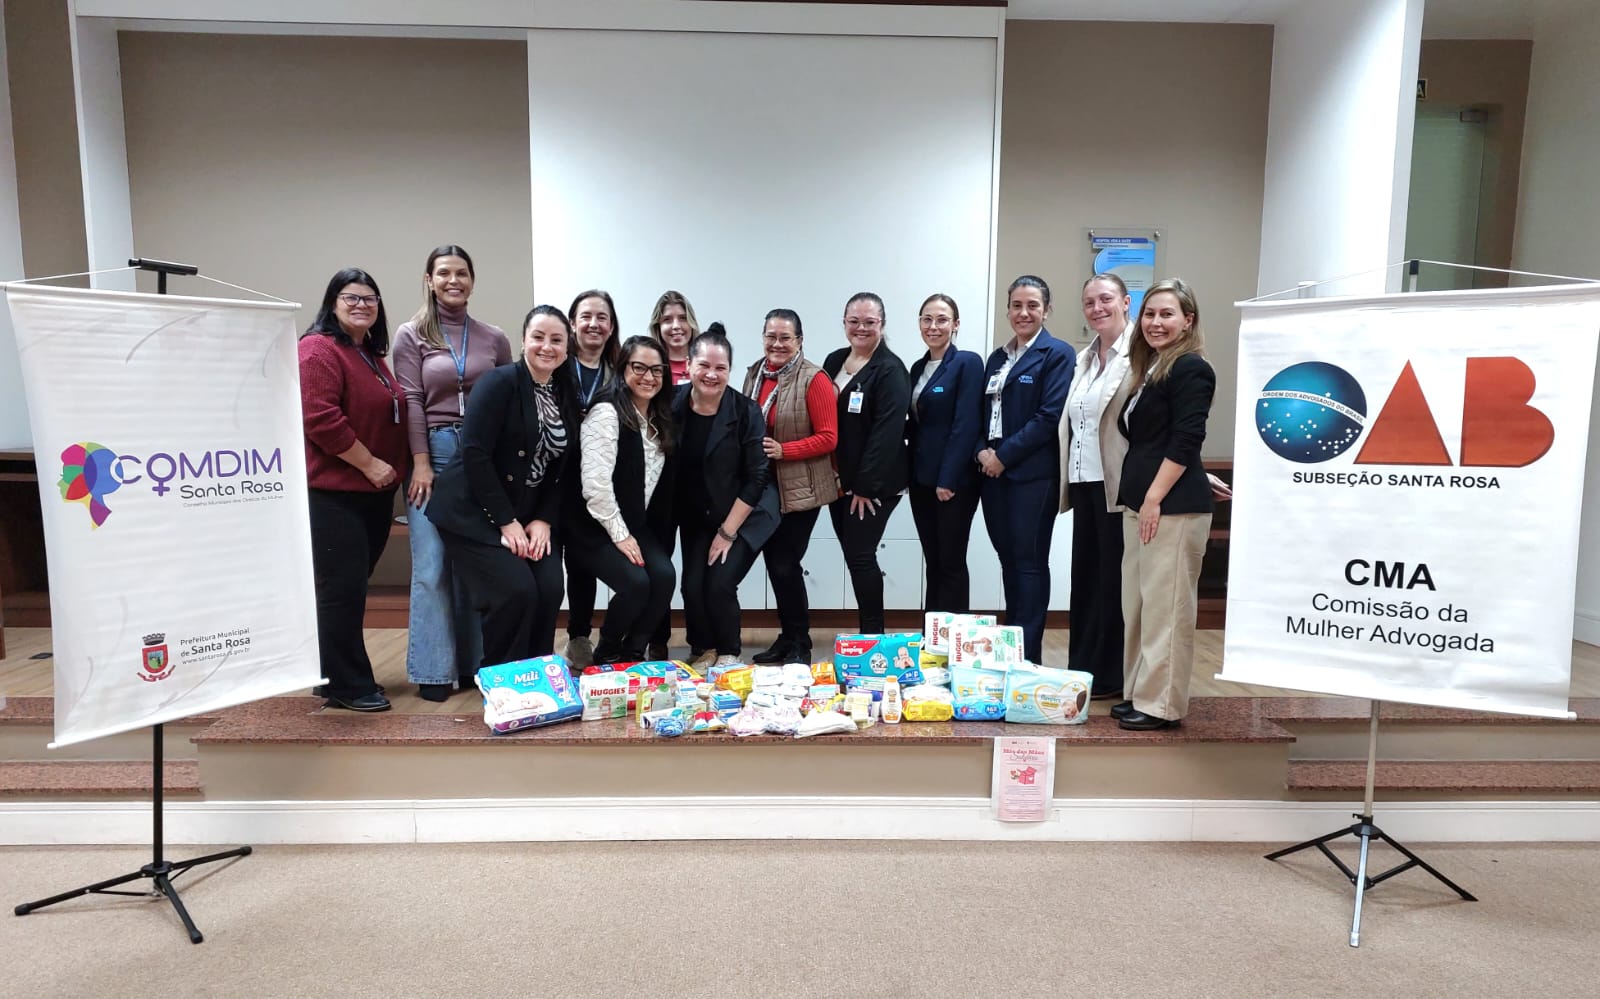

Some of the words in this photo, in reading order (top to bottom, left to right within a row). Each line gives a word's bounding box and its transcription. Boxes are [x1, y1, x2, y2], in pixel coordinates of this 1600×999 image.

[1255, 356, 1555, 468] OAB
[1299, 393, 1336, 408] ADVOGADOS
[1345, 407, 1364, 424] BRASIL
[110, 448, 282, 496] COMDIM
[1293, 470, 1383, 487] SUBSEÇÃO
[1387, 474, 1445, 487] SANTA
[1450, 475, 1501, 489] ROSA
[180, 482, 235, 499] Santa
[241, 480, 284, 494] Rosa
[1344, 558, 1437, 591] CMA
[1312, 593, 1429, 620] Comissão
[1438, 603, 1468, 623] da
[180, 635, 216, 646] Prefeitura
[217, 628, 249, 639] Municipal
[191, 642, 222, 655] Santa
[225, 637, 251, 648] Rosa
[1286, 615, 1364, 641] Mulher
[1369, 624, 1495, 653] Advogada
[513, 670, 539, 685] Mili
[590, 687, 626, 697] HUGGIES
